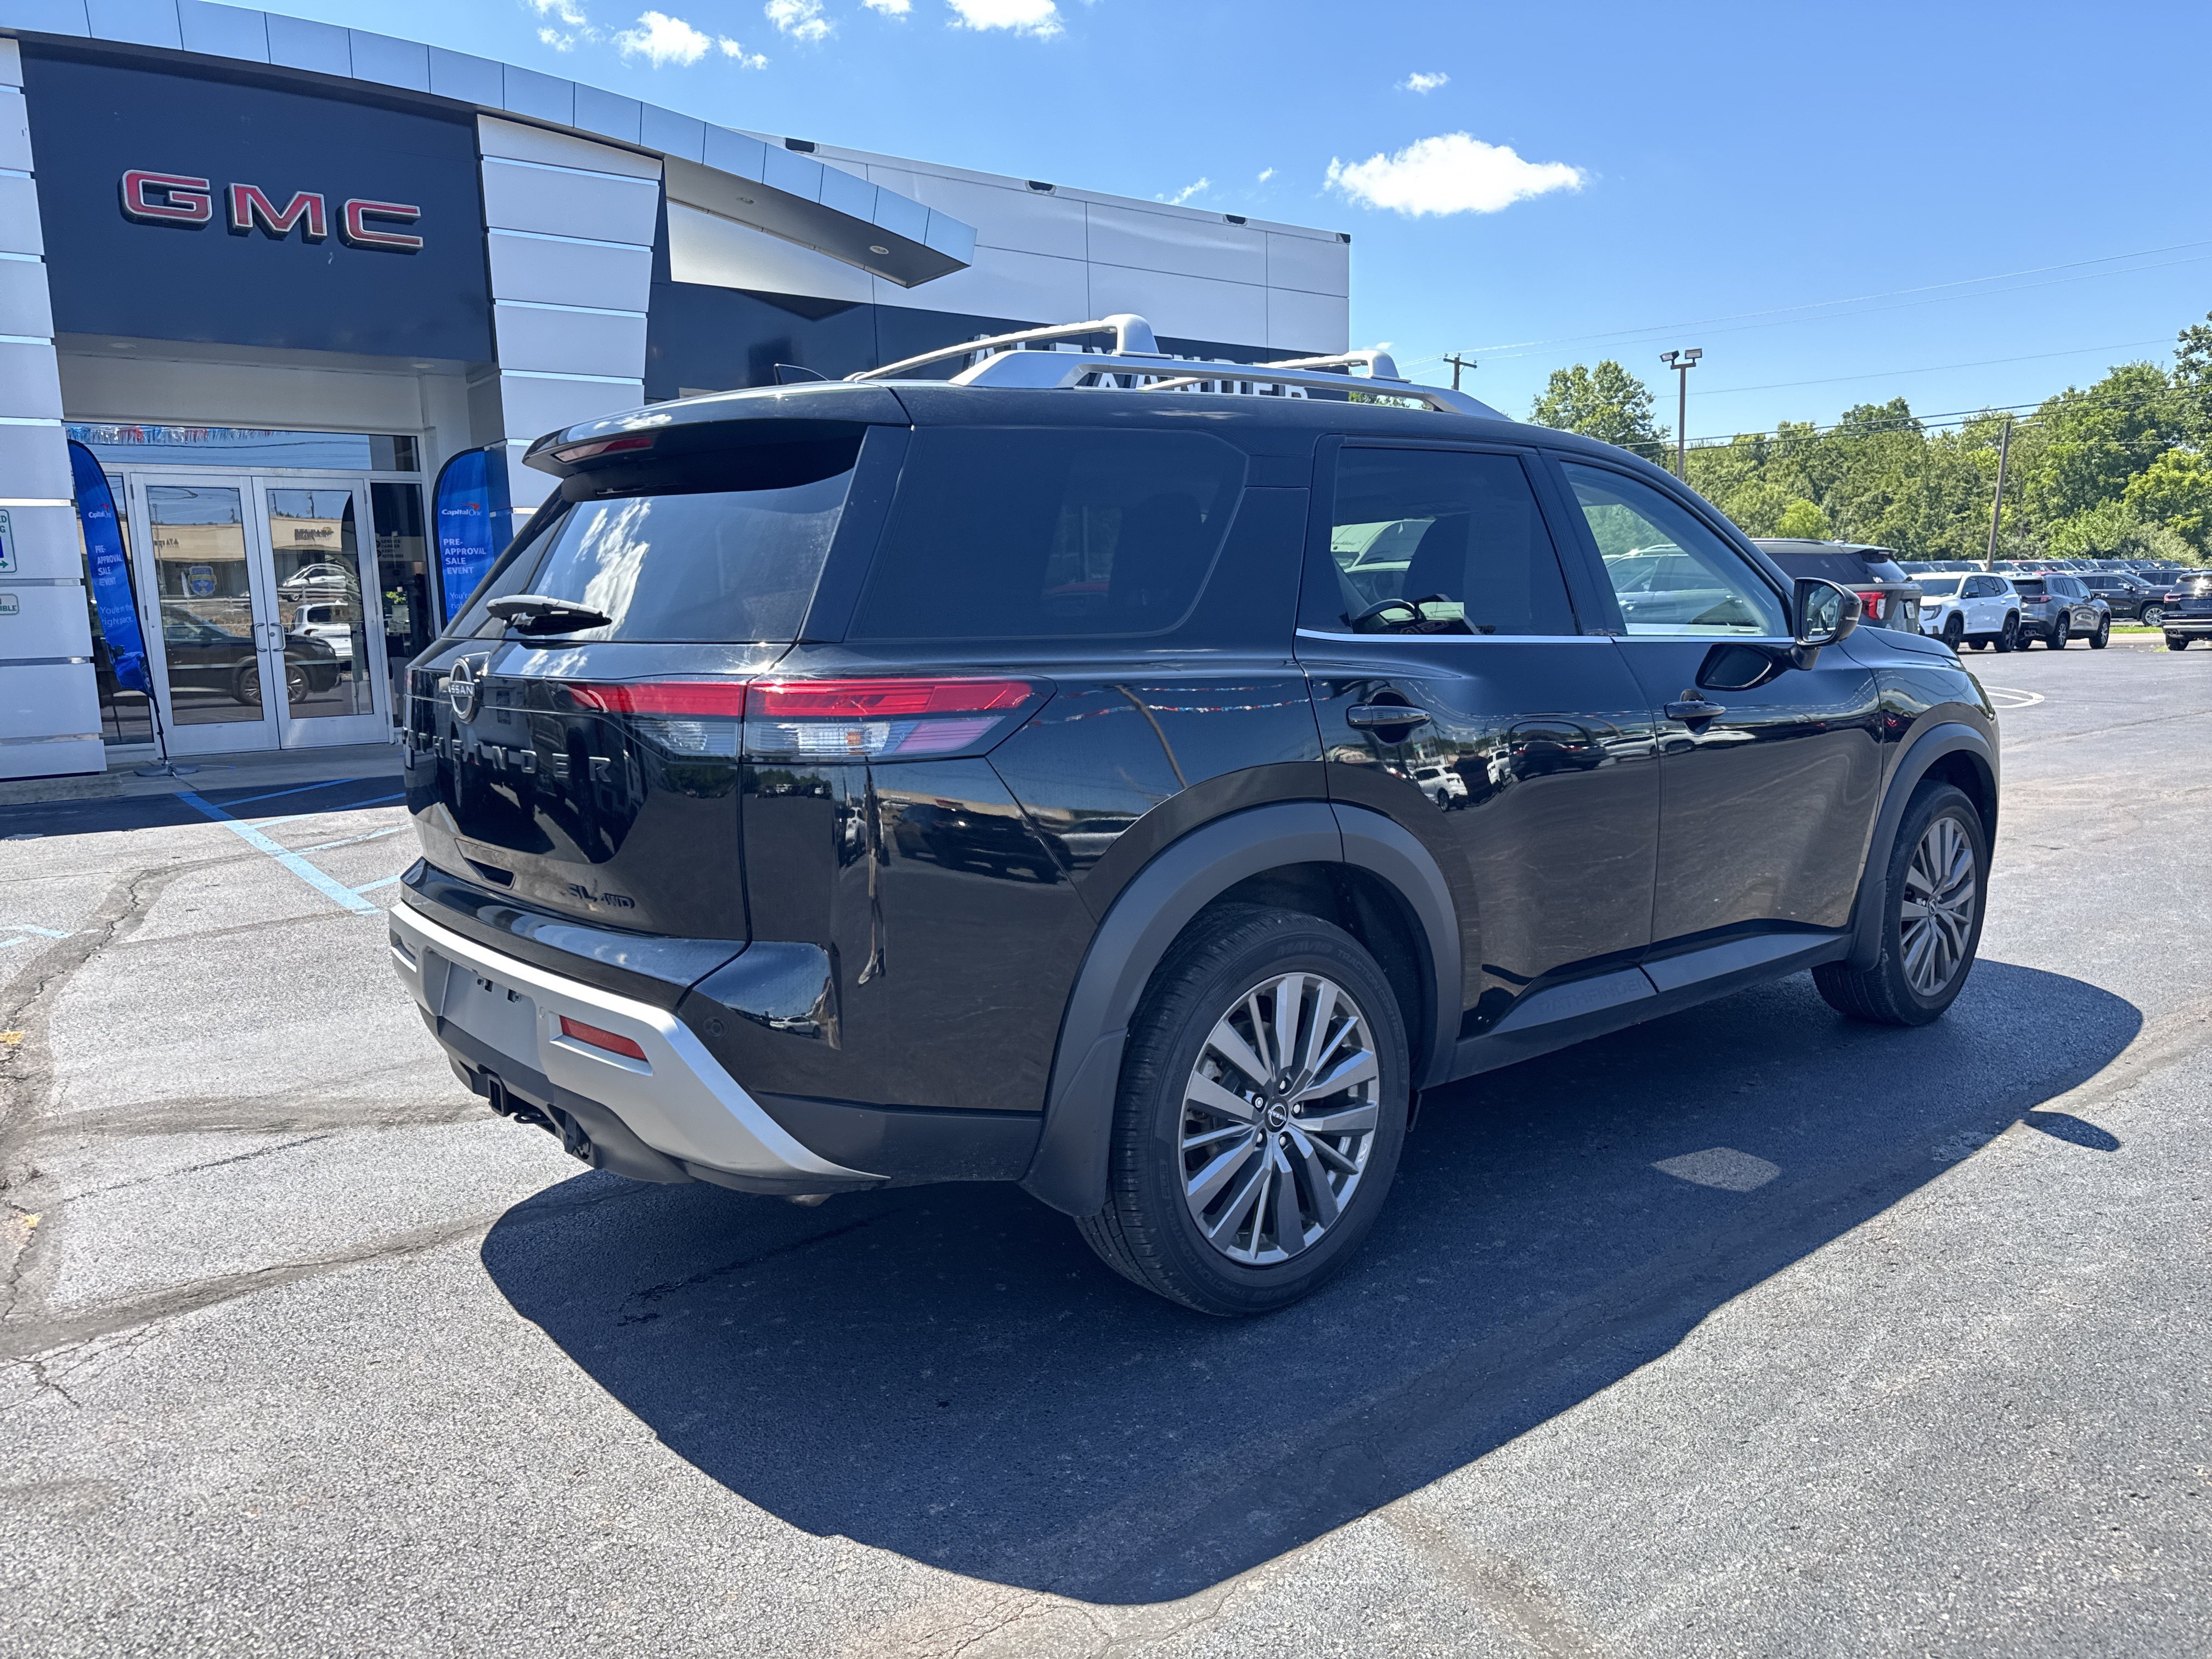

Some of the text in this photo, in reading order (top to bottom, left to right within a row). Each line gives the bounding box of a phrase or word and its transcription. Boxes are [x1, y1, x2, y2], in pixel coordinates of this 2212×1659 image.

[122, 169, 424, 249] GMC
[444, 547, 486, 555] APPROVAL
[447, 566, 474, 574] EVENT
